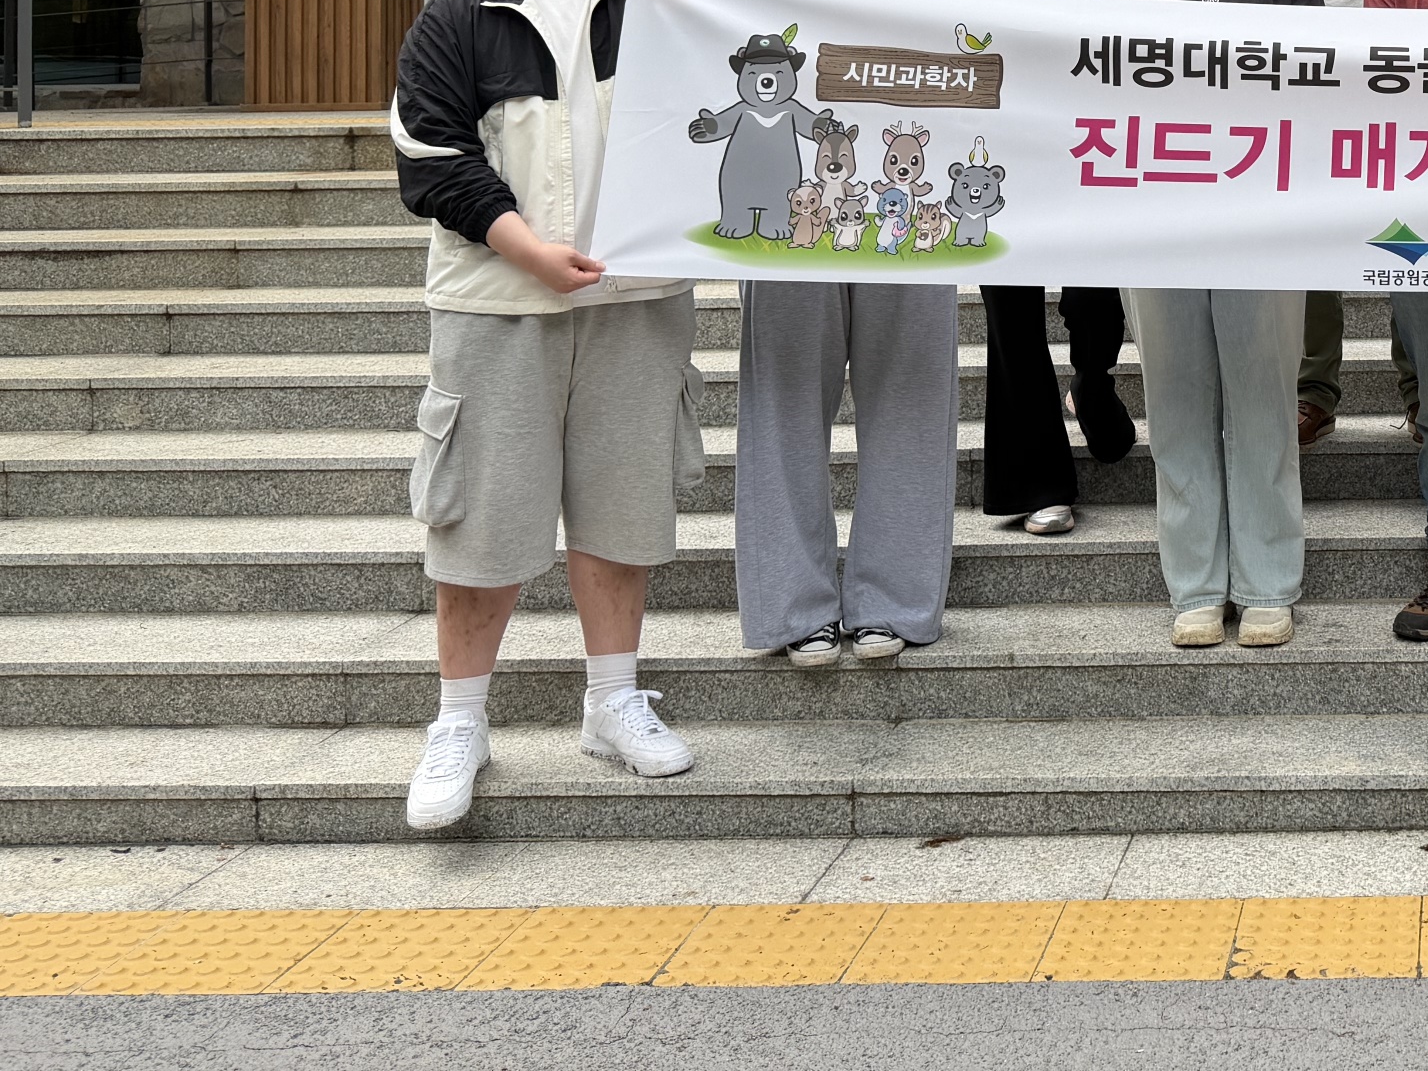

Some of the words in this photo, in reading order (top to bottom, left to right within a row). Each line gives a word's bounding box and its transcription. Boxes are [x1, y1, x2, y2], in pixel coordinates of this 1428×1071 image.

[841, 60, 978, 92] 시민과학자
[1070, 34, 1341, 91] 세명대학교
[1068, 115, 1293, 192] 진드기
